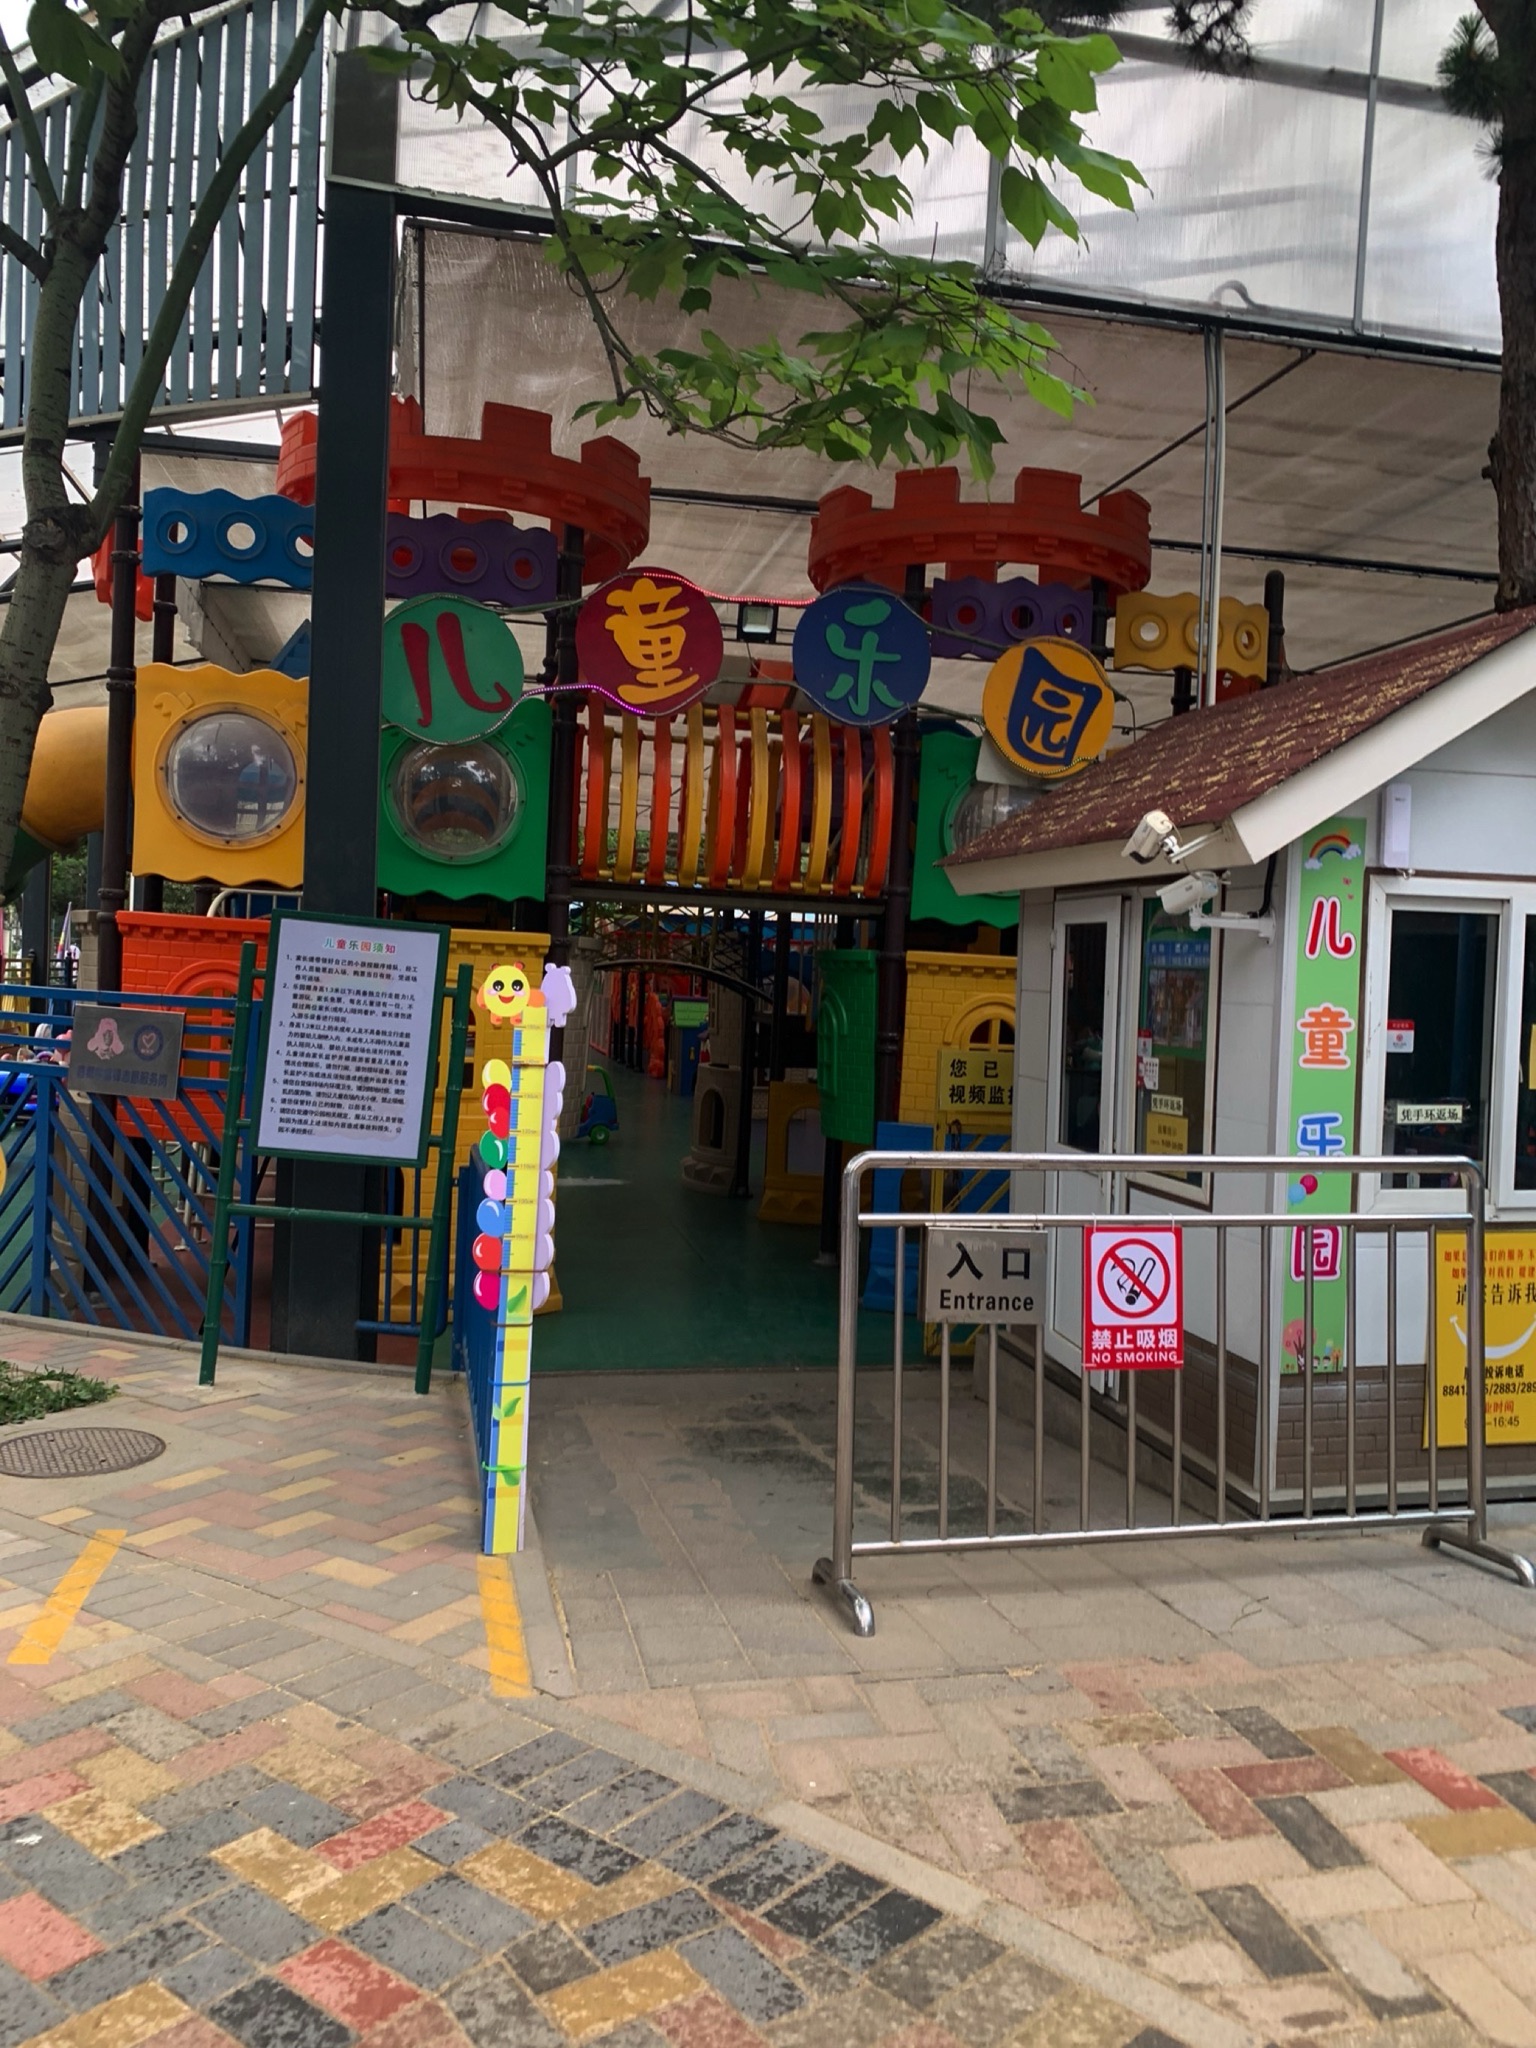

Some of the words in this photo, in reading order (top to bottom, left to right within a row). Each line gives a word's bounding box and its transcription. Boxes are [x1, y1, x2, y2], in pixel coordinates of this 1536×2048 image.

[322, 937, 396, 954] 儿童乐园须知
[1293, 893, 1358, 1282] 儿童乐园
[1400, 1108, 1460, 1122] 凭手环返场
[947, 1241, 1031, 1280] 入口
[940, 1289, 1034, 1311] Entrance
[1092, 1327, 1178, 1350] 禁止吸烟
[1091, 1352, 1111, 1364] NO
[1115, 1350, 1177, 1363] SMOKING
